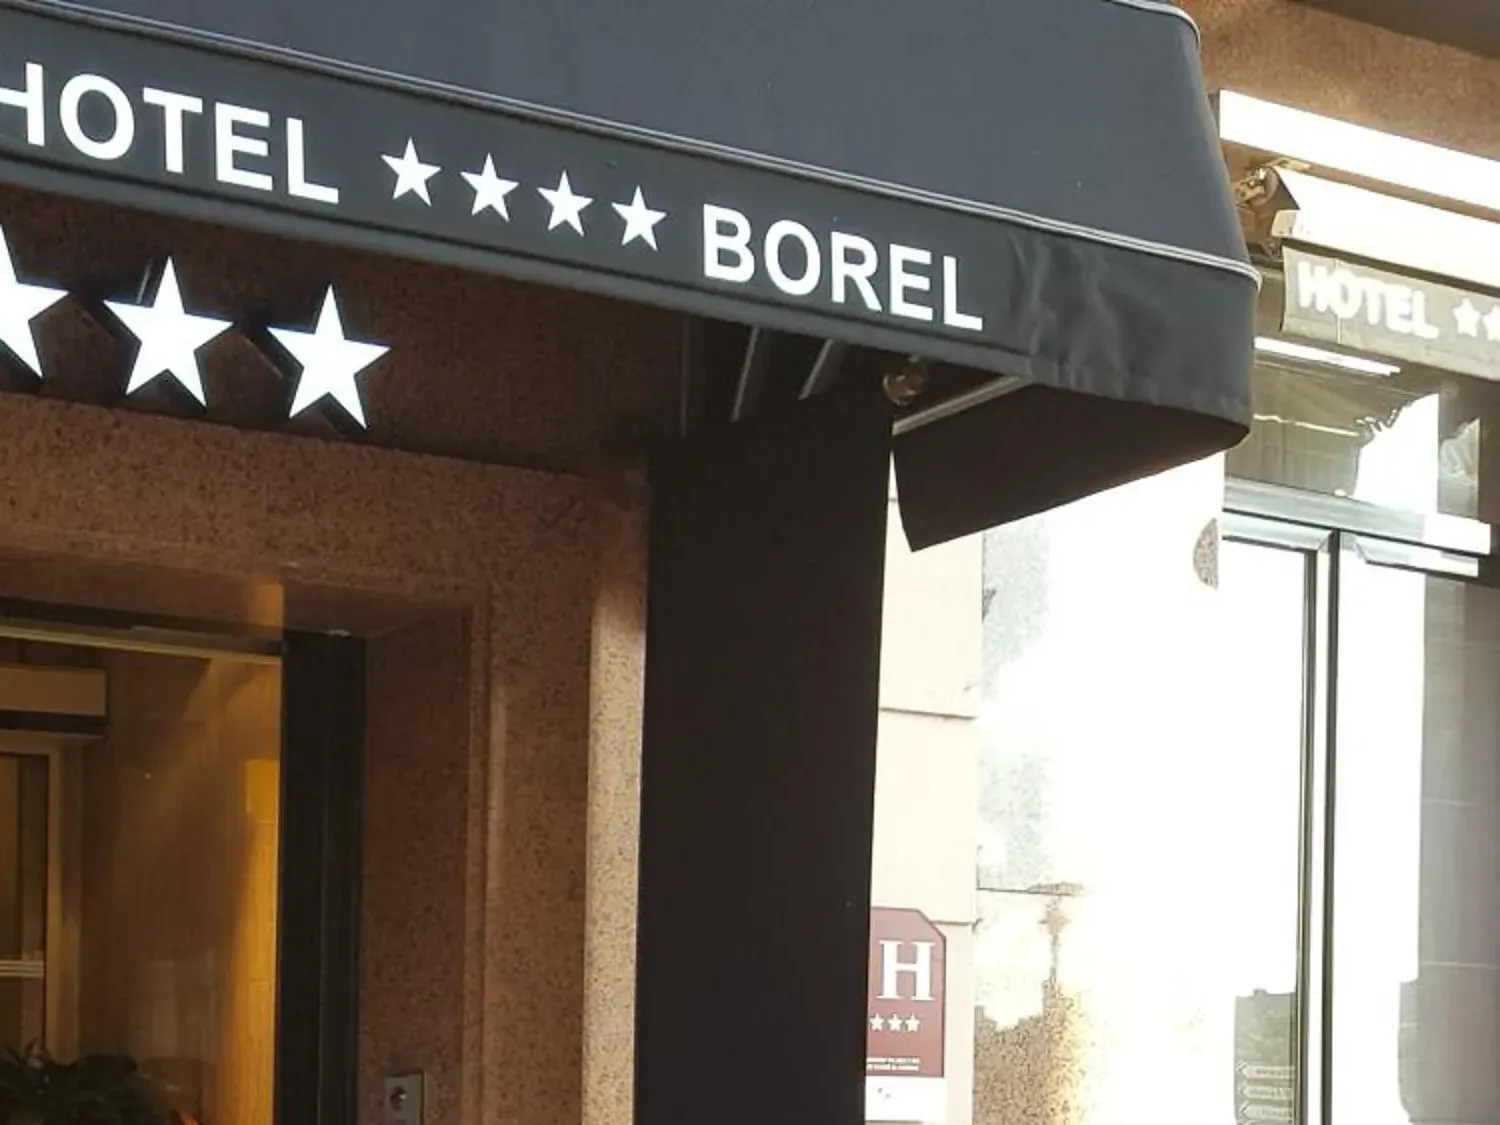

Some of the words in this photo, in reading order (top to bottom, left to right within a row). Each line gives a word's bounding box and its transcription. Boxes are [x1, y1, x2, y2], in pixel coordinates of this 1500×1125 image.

[703, 203, 984, 332] BOREL
[1297, 260, 1440, 339] HOTEL
[876, 939, 936, 1001] H
